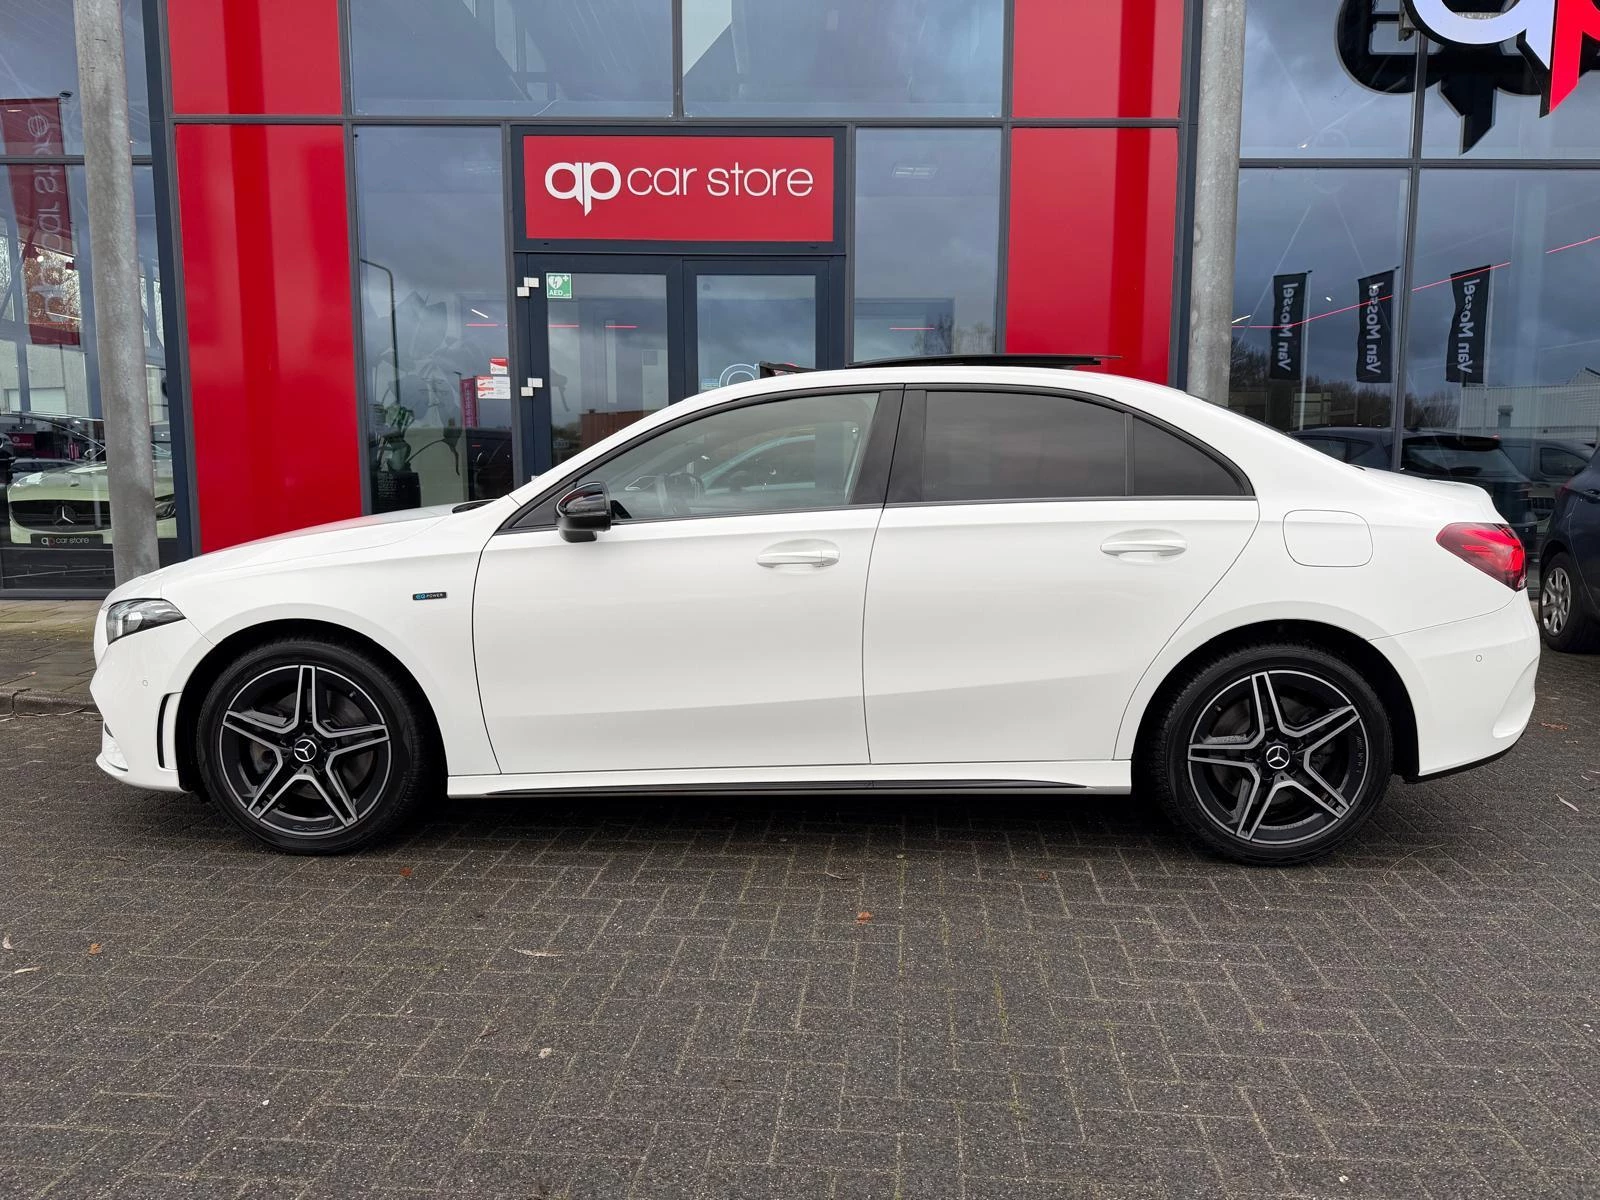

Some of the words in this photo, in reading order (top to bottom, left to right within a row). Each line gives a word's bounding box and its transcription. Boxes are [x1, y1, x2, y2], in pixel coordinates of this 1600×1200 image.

[544, 161, 622, 217] ap
[626, 167, 698, 197] car
[706, 162, 814, 197] store
[69, 536, 90, 544] store
